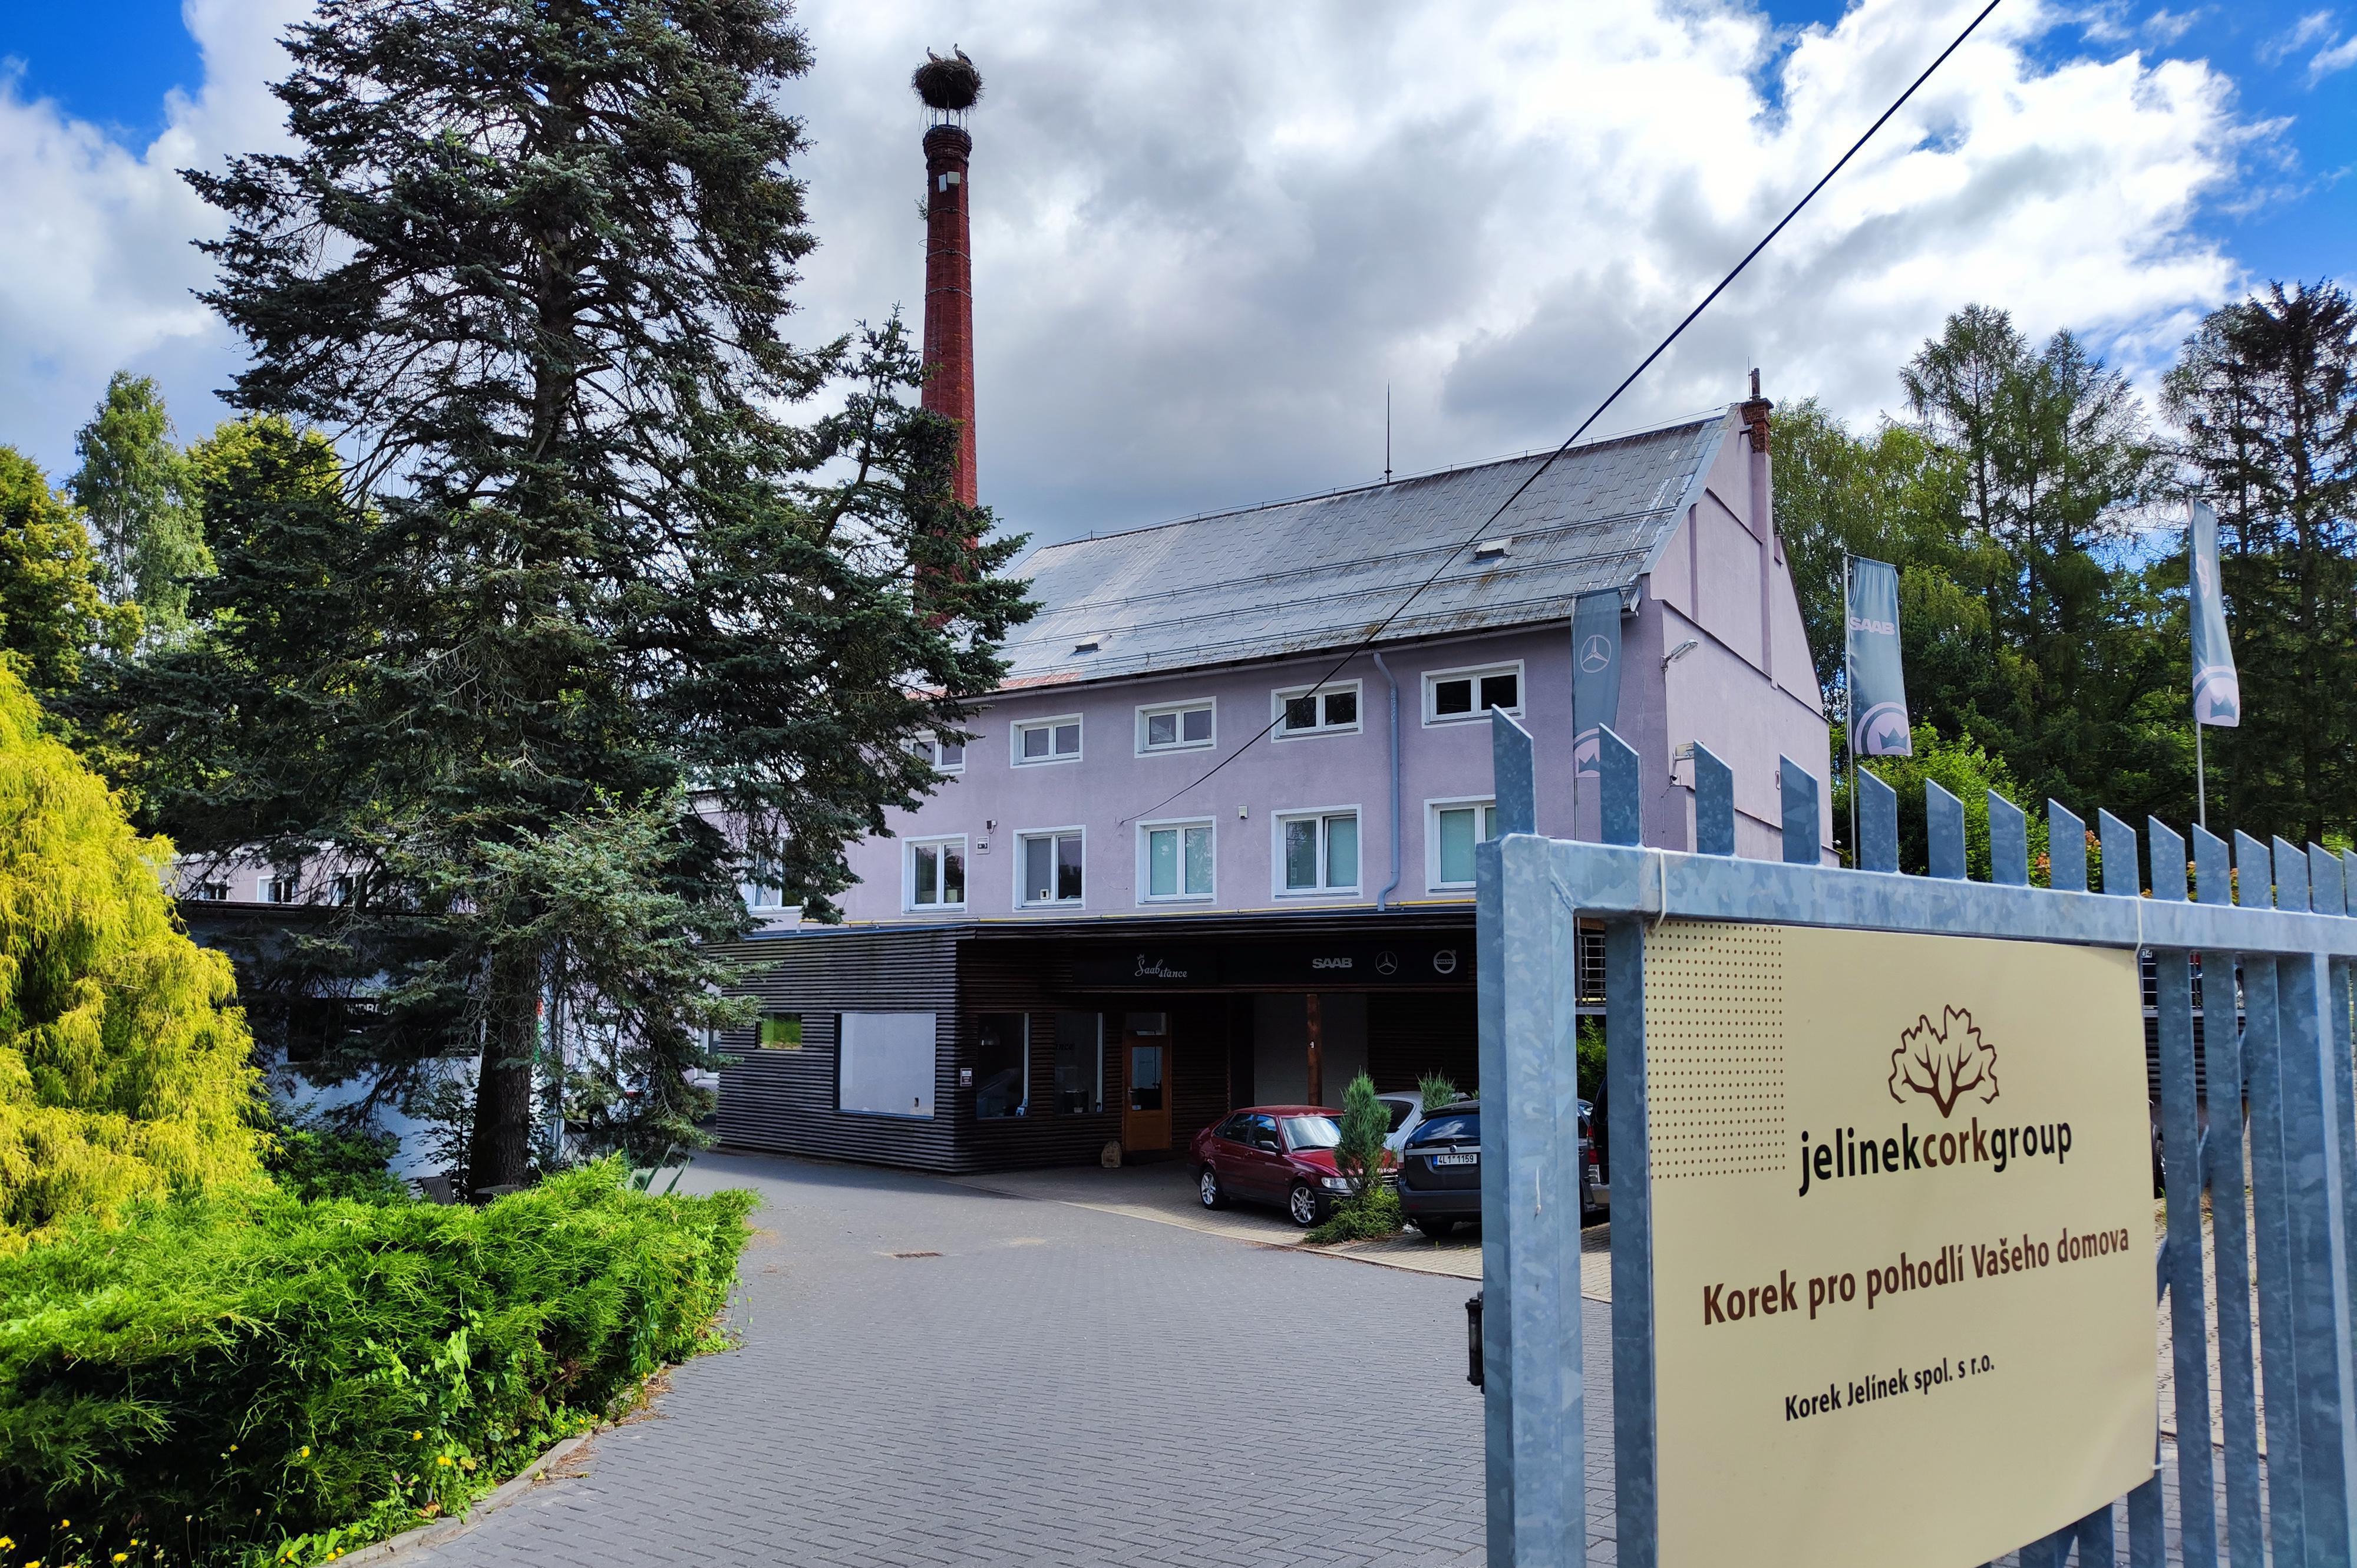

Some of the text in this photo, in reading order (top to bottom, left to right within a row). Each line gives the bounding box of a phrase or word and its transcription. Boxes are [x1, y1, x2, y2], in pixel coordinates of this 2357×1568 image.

[1849, 616, 1895, 635] SAAB
[1312, 958, 1352, 969] SAAB
[1438, 1156, 1452, 1164] 4L1
[1457, 1155, 1474, 1163] 1159
[1799, 1117, 2072, 1197] jelinekcorkgroup
[1704, 1227, 2129, 1326] Korek pro pohodlí Vašeho domova
[1785, 1355, 1995, 1422] Korek Jelínek spol. s r.o.
